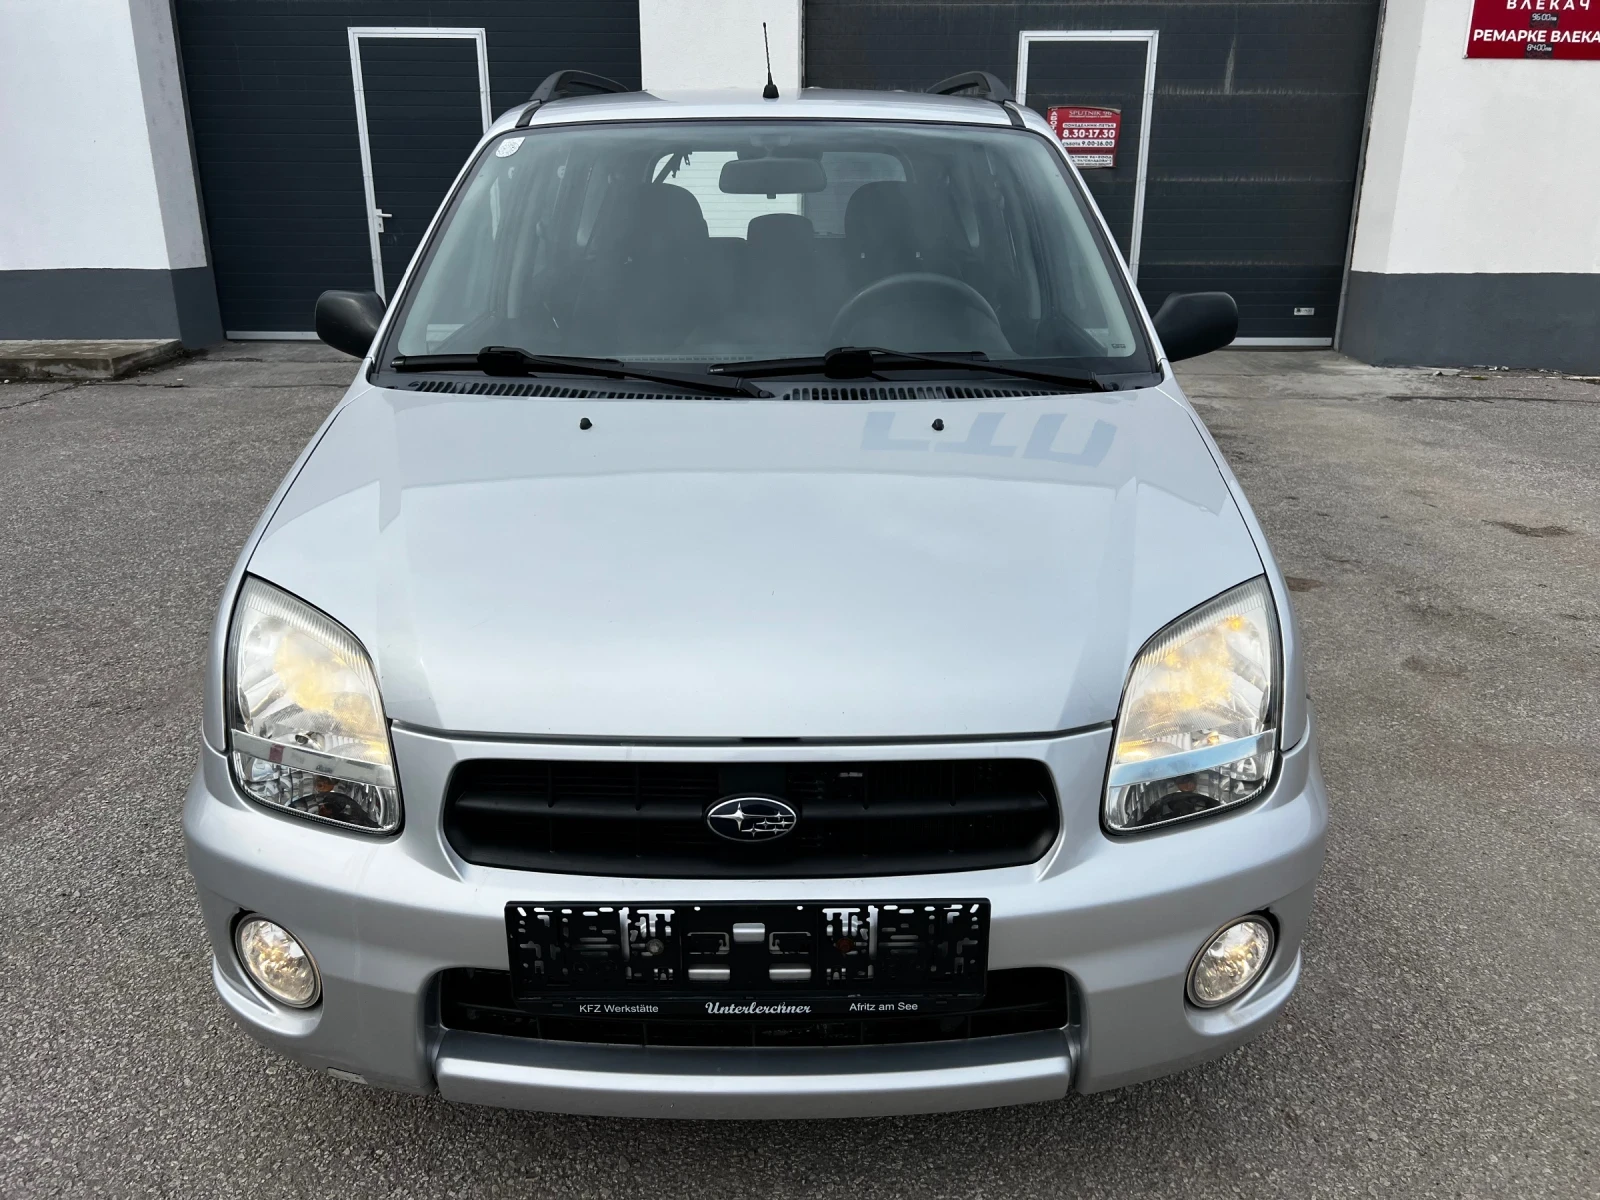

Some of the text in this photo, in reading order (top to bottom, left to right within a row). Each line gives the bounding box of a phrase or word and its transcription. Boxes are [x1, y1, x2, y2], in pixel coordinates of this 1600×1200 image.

[1506, 0, 1591, 10] ВЛЕКАЧ
[1473, 29, 1548, 42] РЕМАРКЕ
[1062, 130, 1116, 138] 8.30-17.30
[579, 1004, 659, 1013] KFZ Werkstätte
[849, 1001, 918, 1011] Afritz am See
